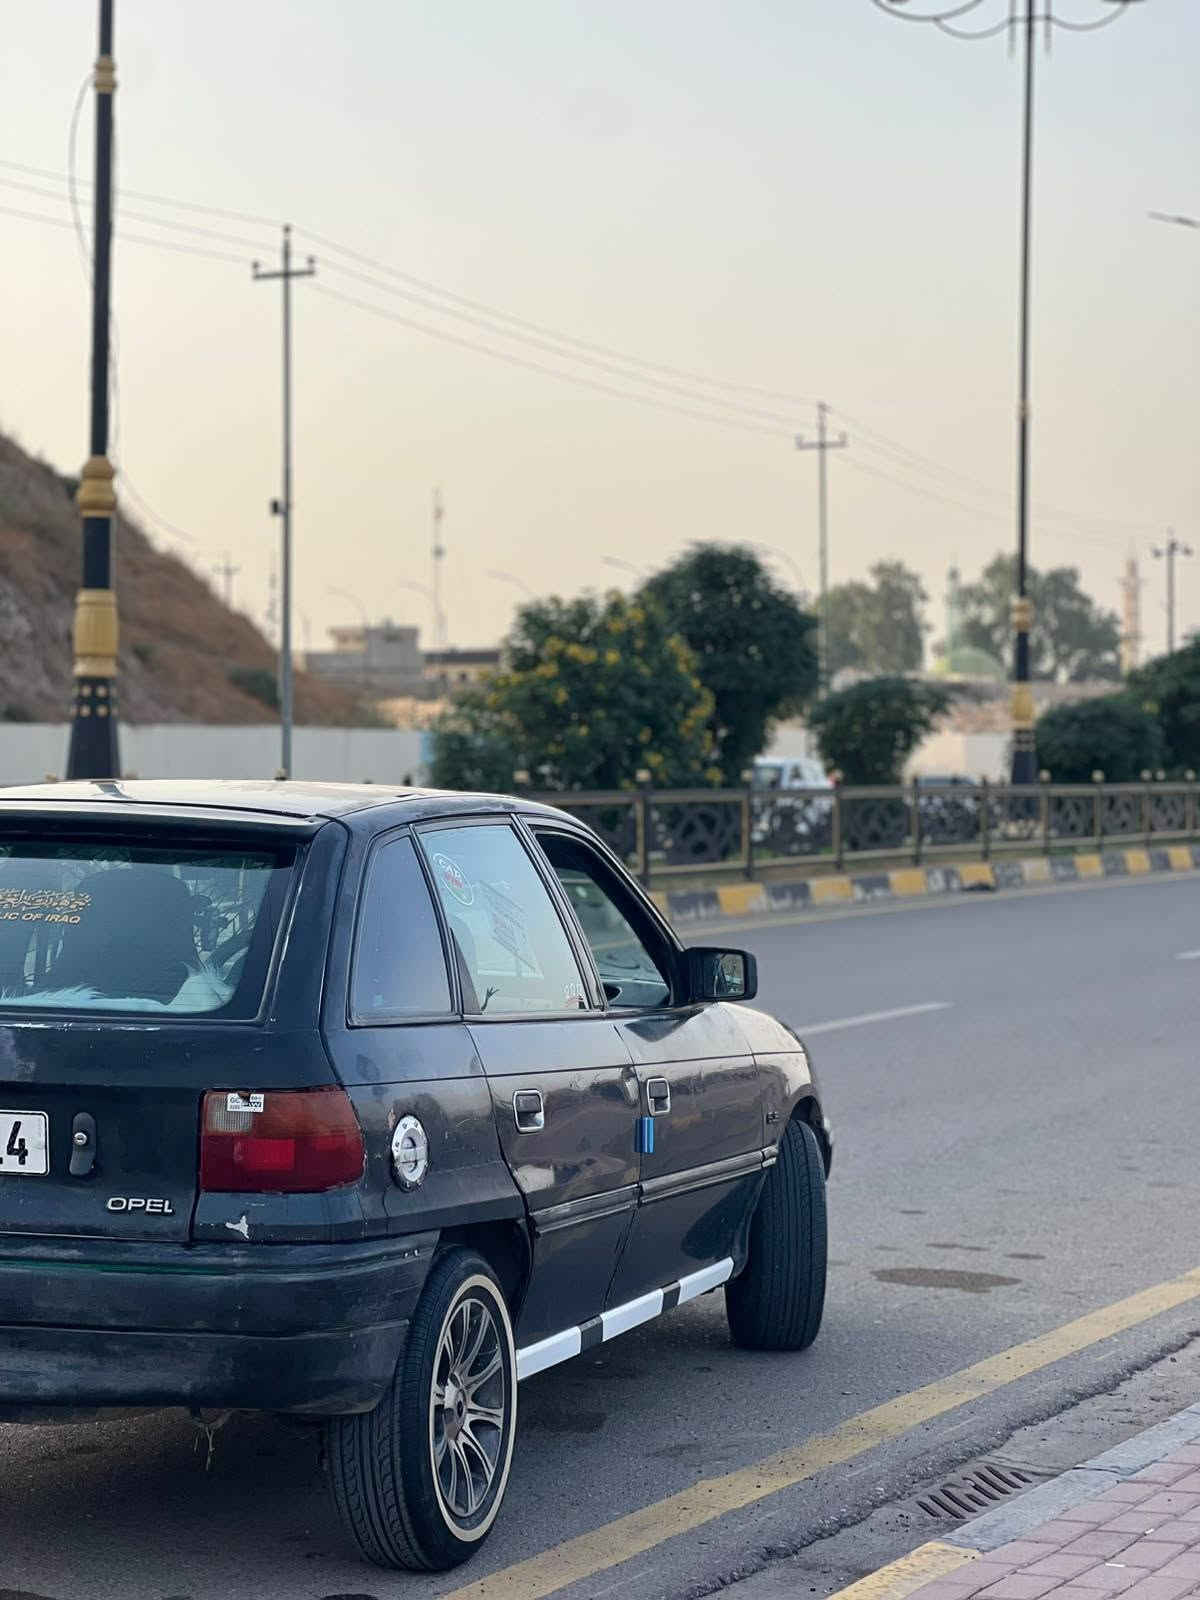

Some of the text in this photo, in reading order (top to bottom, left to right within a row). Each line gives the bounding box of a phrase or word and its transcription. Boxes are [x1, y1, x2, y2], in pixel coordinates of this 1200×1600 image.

[21, 912, 43, 921] OF
[44, 913, 81, 924] IRAQ
[0, 1121, 28, 1165] 4
[106, 1197, 174, 1214] OPEL
